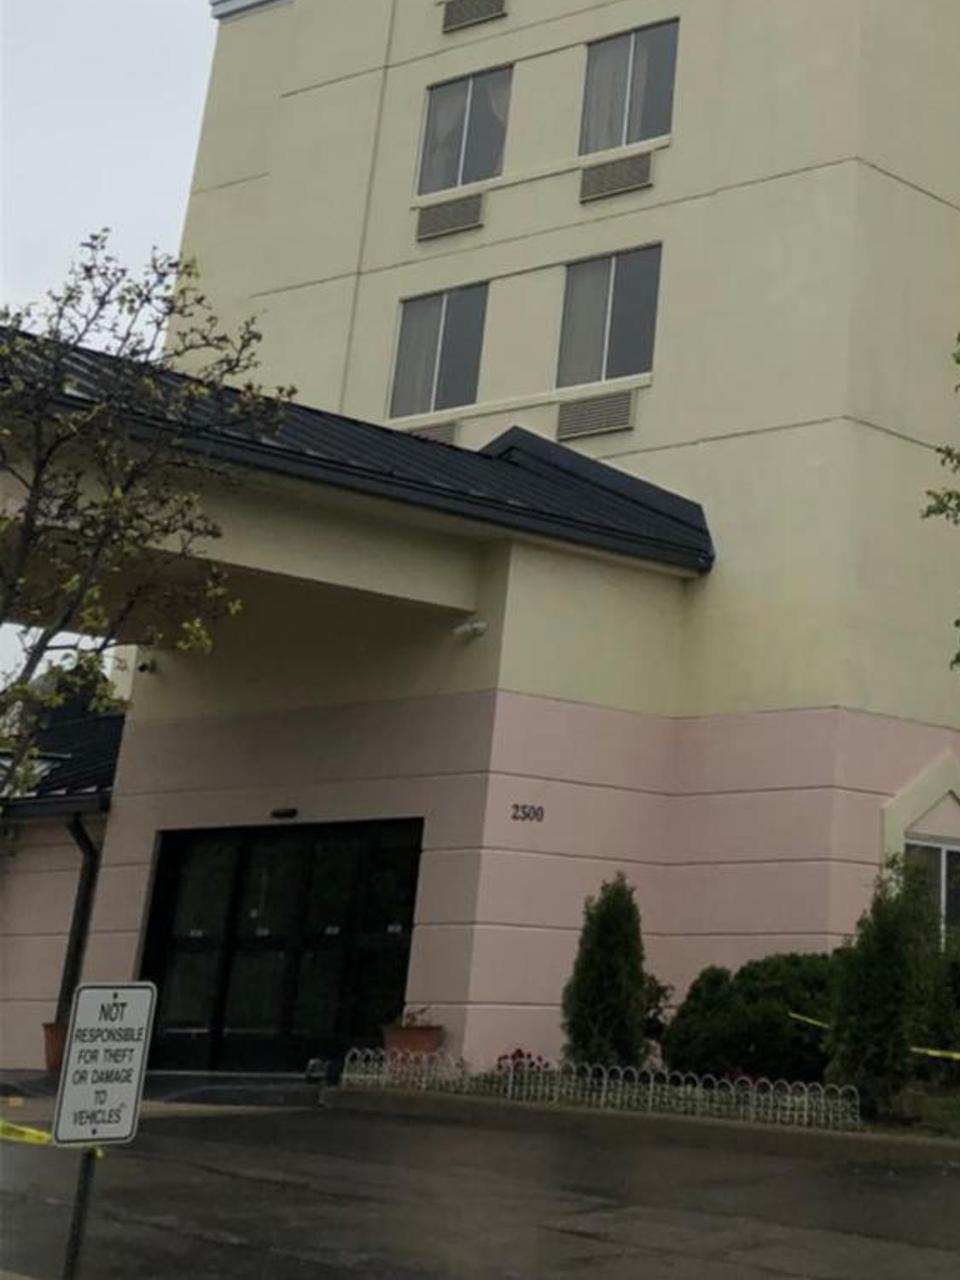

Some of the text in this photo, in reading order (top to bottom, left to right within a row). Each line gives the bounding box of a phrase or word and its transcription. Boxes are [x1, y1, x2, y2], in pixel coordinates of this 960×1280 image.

[511, 803, 545, 823] 2500
[98, 1002, 128, 1021] NOT
[74, 1027, 145, 1043] RESPONSIBLE
[77, 1048, 135, 1064] FOR THEFT
[71, 1070, 134, 1085] OR DAMAGE
[94, 1090, 107, 1105] TO
[72, 1108, 122, 1126] VEHICLES
